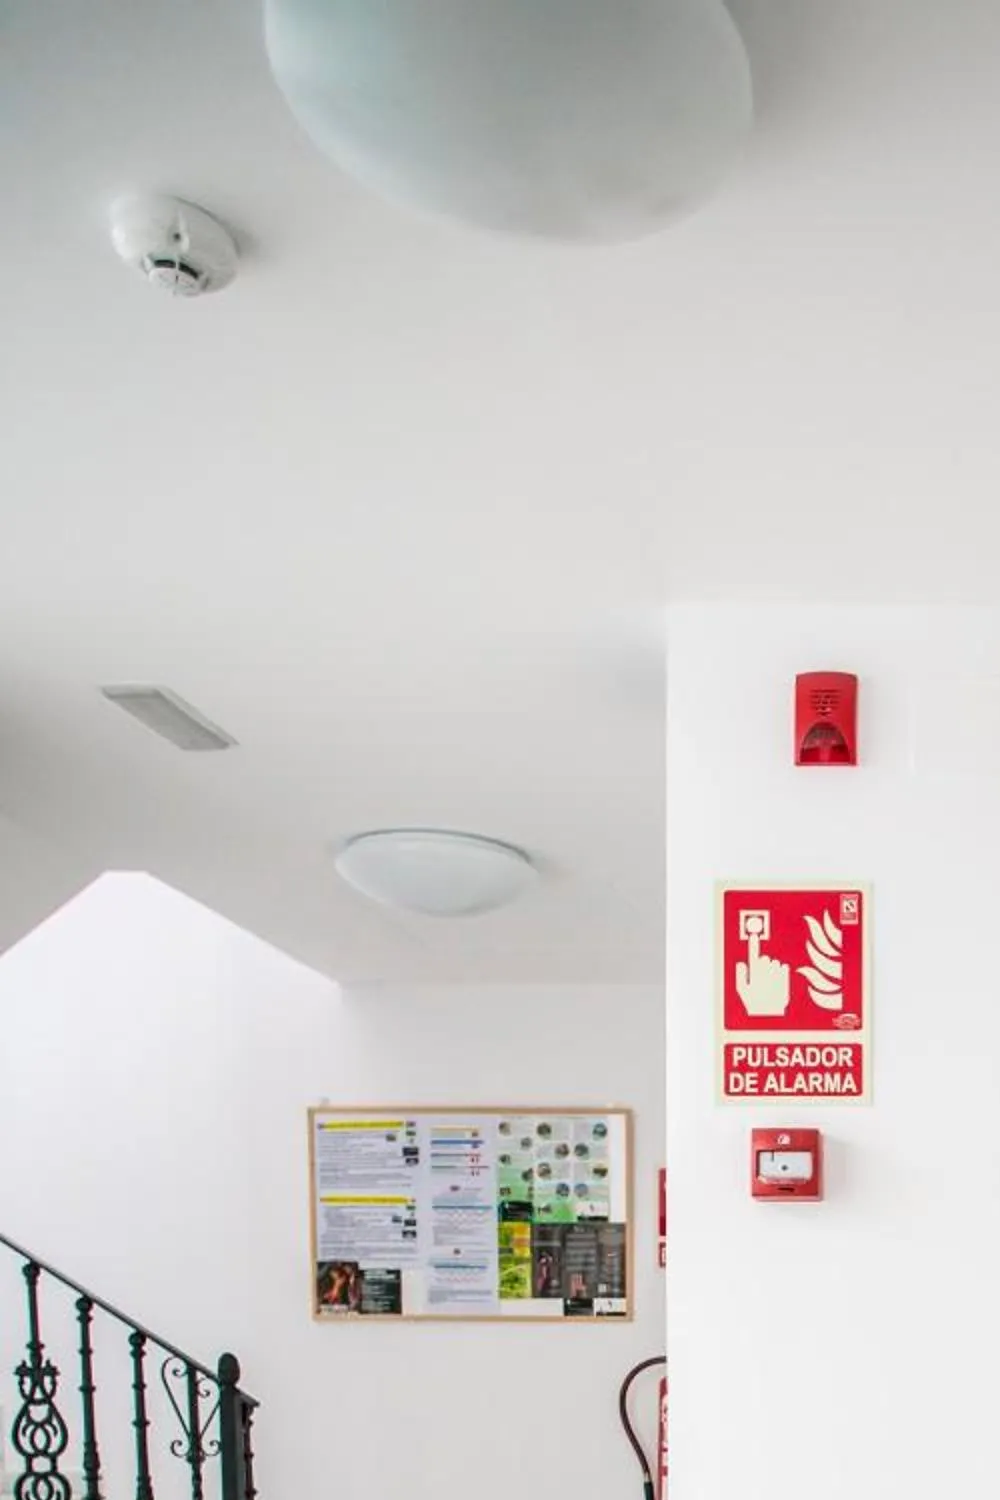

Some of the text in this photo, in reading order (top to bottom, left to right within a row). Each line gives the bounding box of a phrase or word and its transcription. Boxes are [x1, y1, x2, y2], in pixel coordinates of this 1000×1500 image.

[732, 1046, 854, 1067] PULSADOR
[728, 1072, 858, 1093] DE ALARMA
